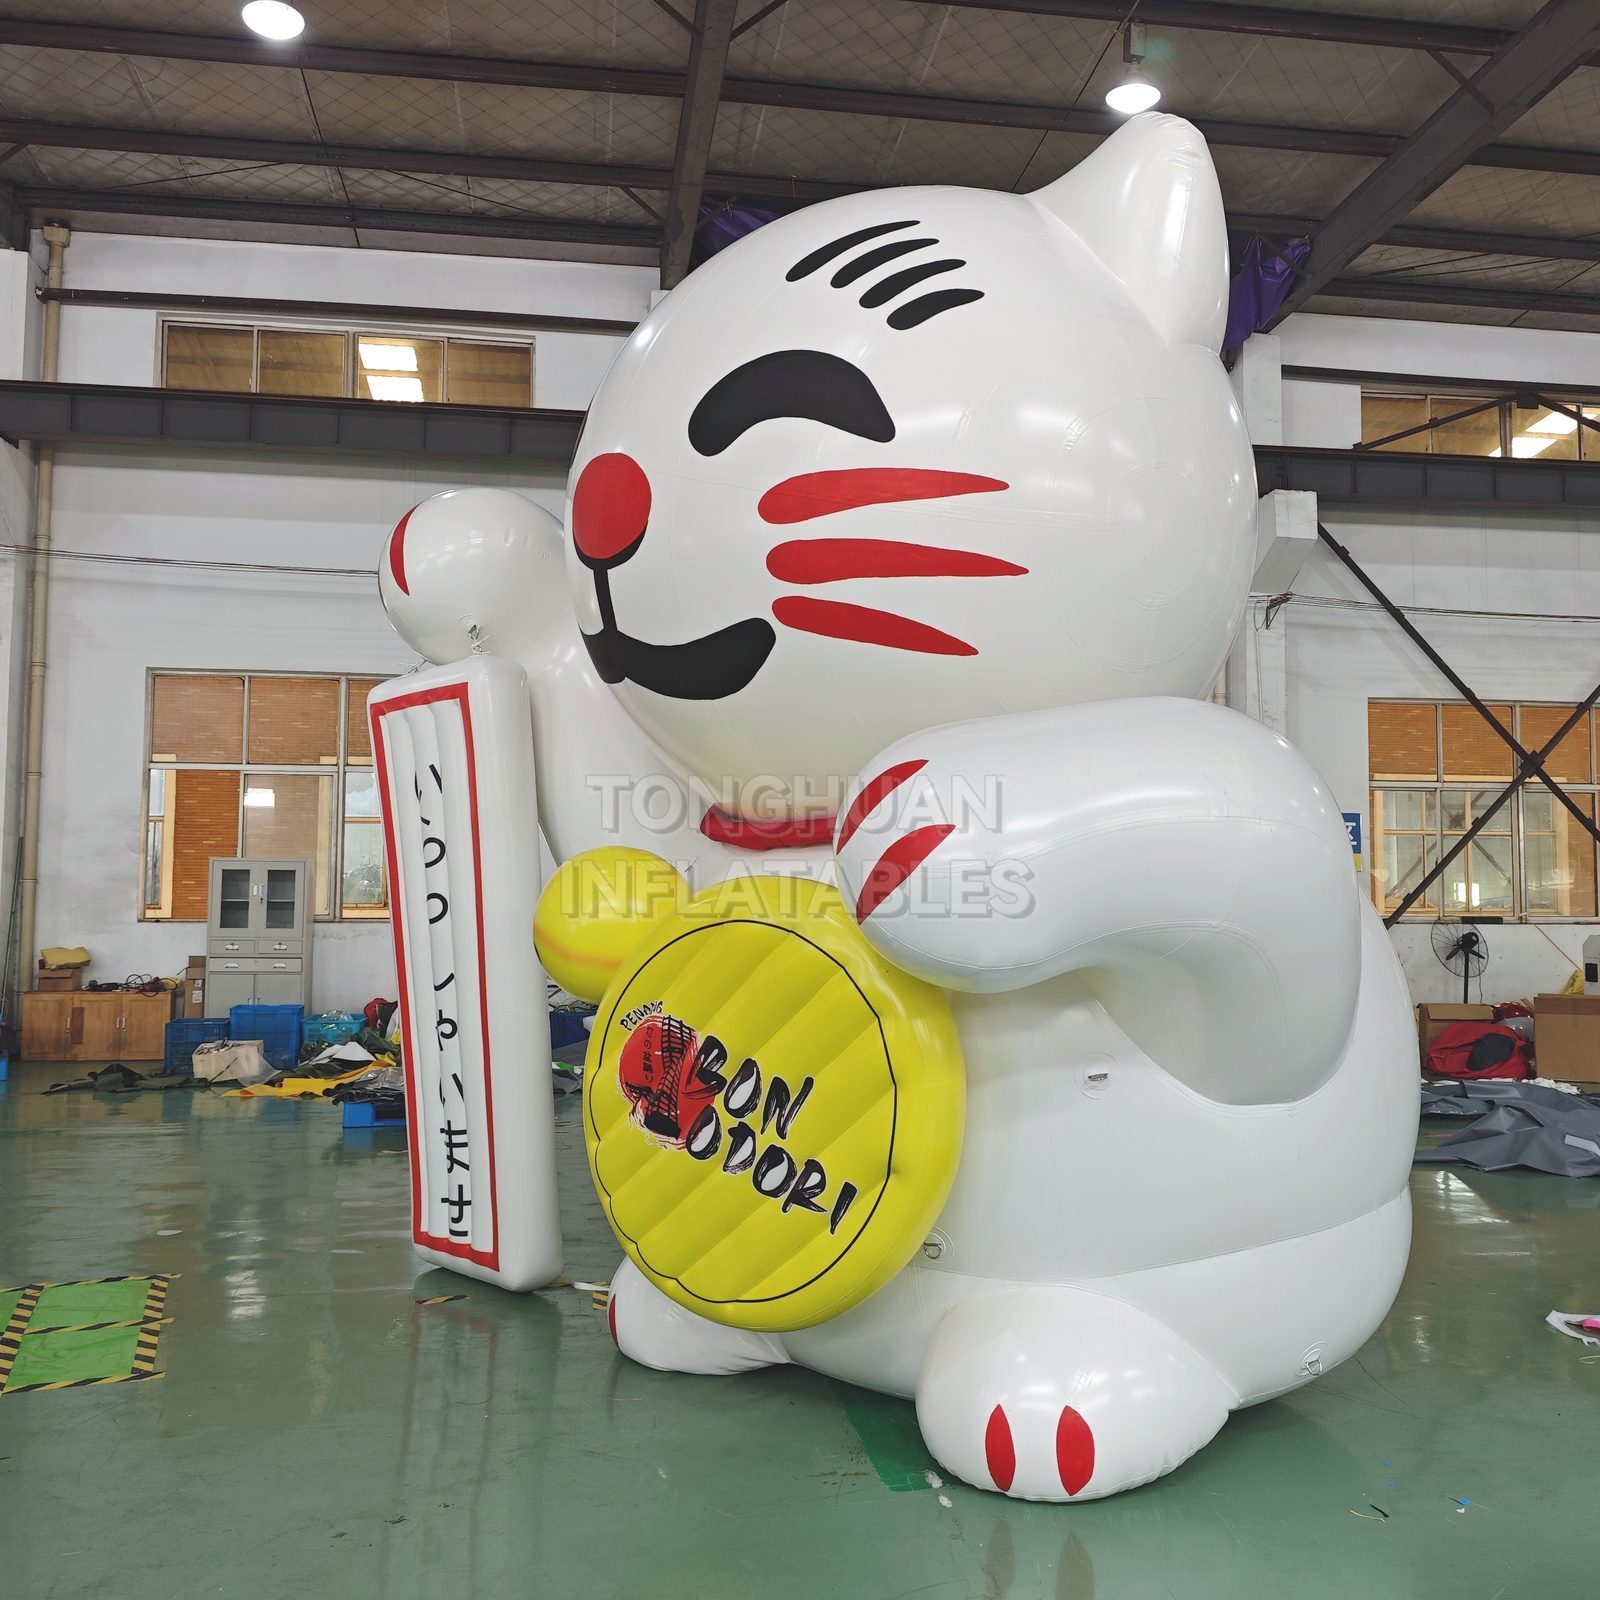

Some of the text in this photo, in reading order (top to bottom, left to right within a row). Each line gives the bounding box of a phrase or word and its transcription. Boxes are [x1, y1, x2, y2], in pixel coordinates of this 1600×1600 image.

[620, 1000, 663, 1031] PENANG
[683, 1035, 815, 1140] BON
[686, 1105, 858, 1236] ODORI
